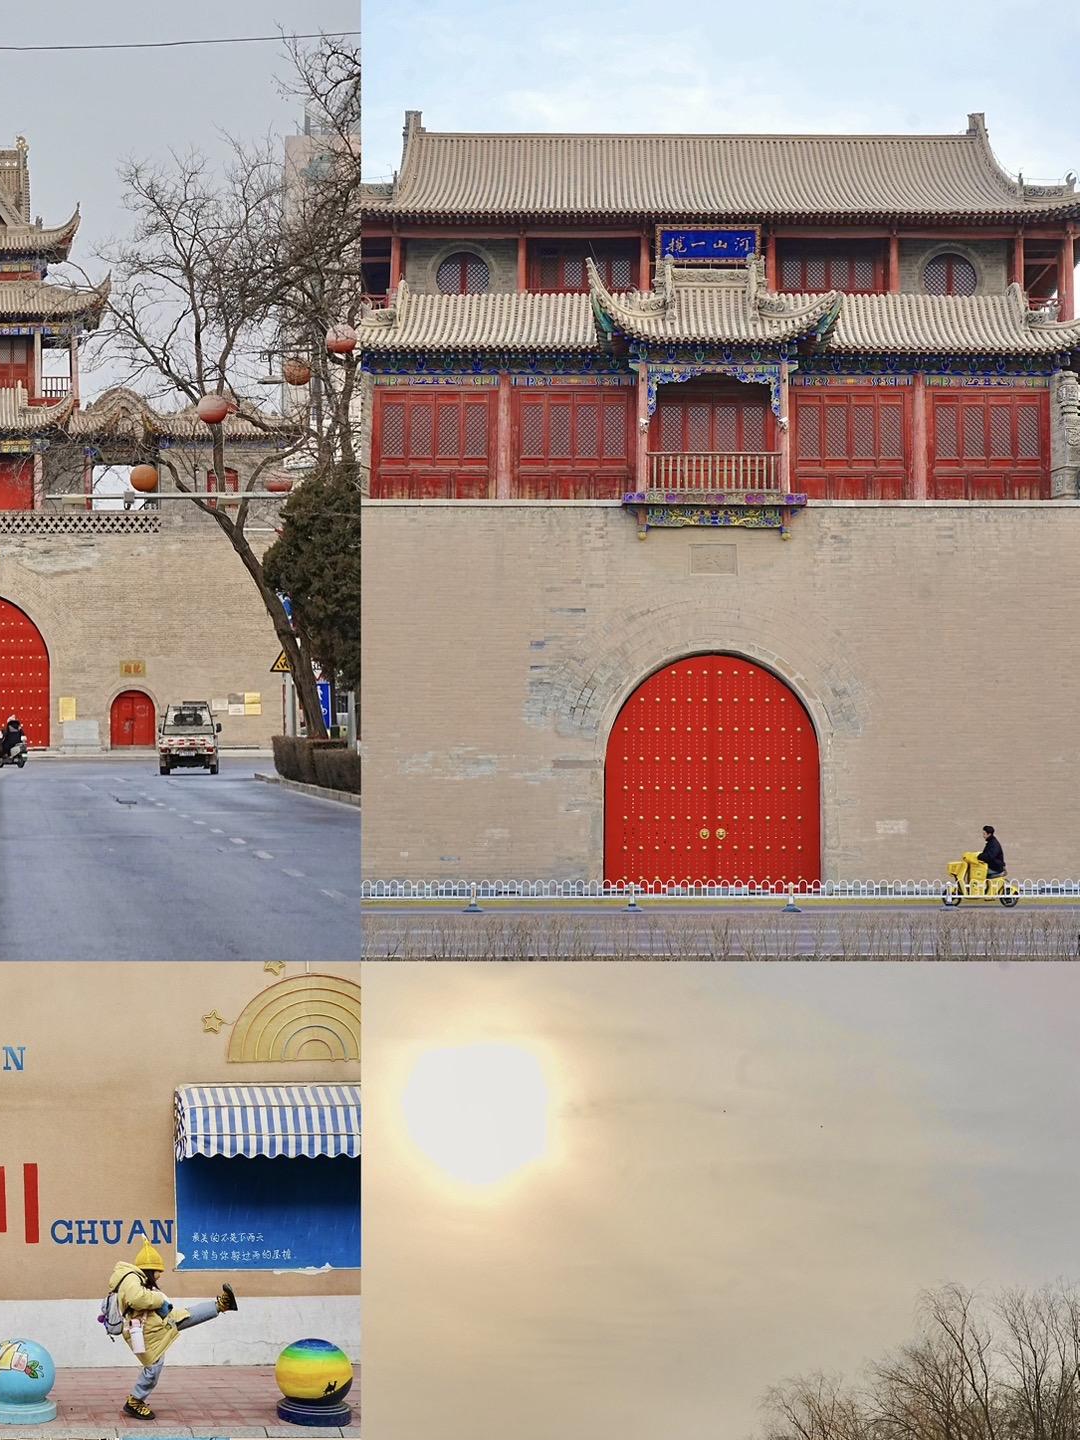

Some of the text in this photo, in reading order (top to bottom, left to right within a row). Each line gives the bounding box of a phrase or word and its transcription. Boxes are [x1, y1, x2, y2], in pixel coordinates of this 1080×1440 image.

[50, 1219, 174, 1245] CHUAN
[191, 1231, 265, 1244] 最美的不是下雨天
